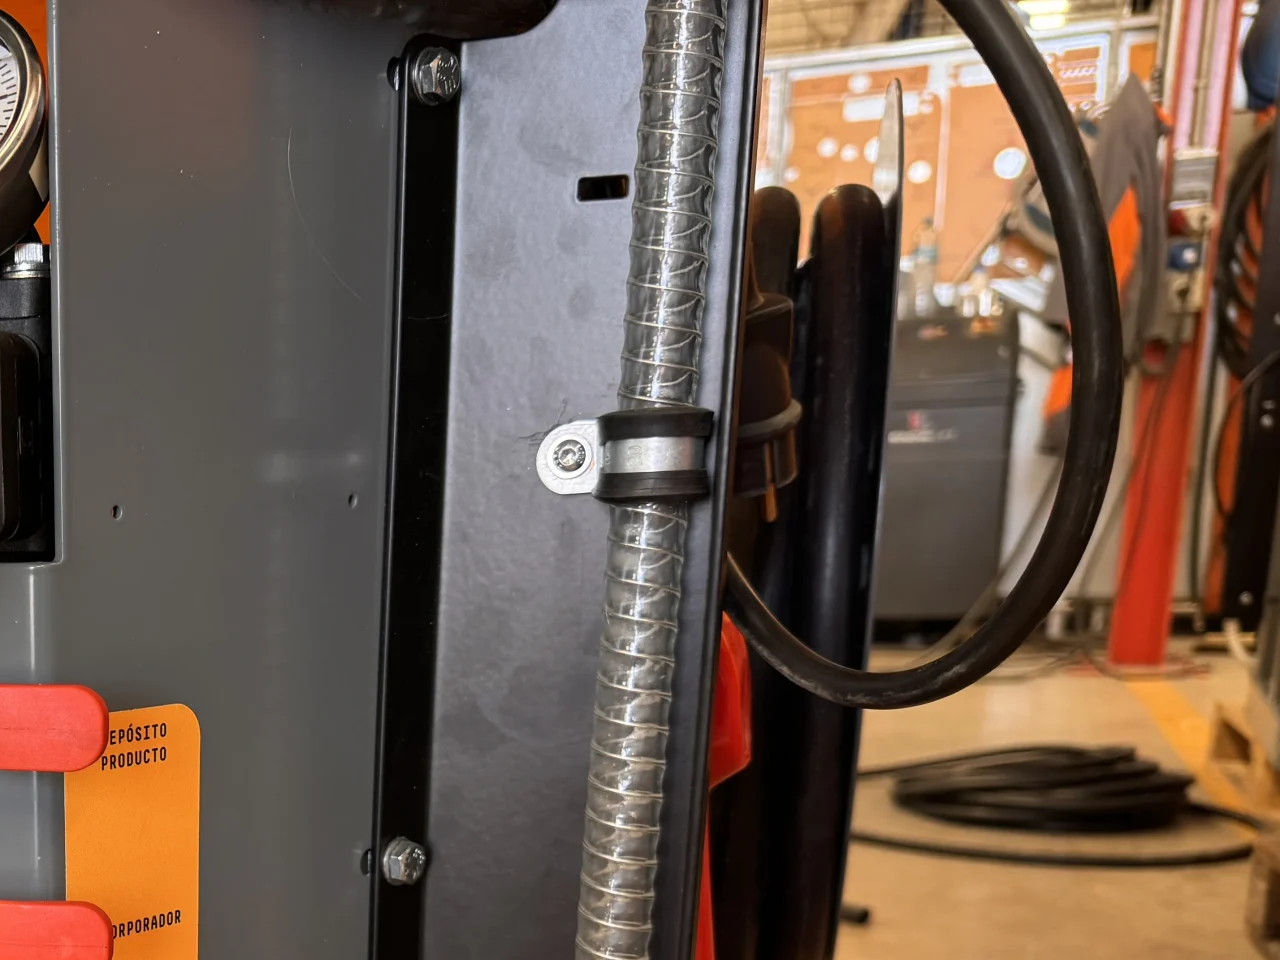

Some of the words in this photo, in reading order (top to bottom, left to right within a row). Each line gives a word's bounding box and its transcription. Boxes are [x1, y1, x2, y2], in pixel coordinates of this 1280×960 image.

[109, 722, 167, 746] EPÓSITO
[101, 746, 167, 771] PRODUCTO
[112, 909, 181, 940] ORPORADOR
